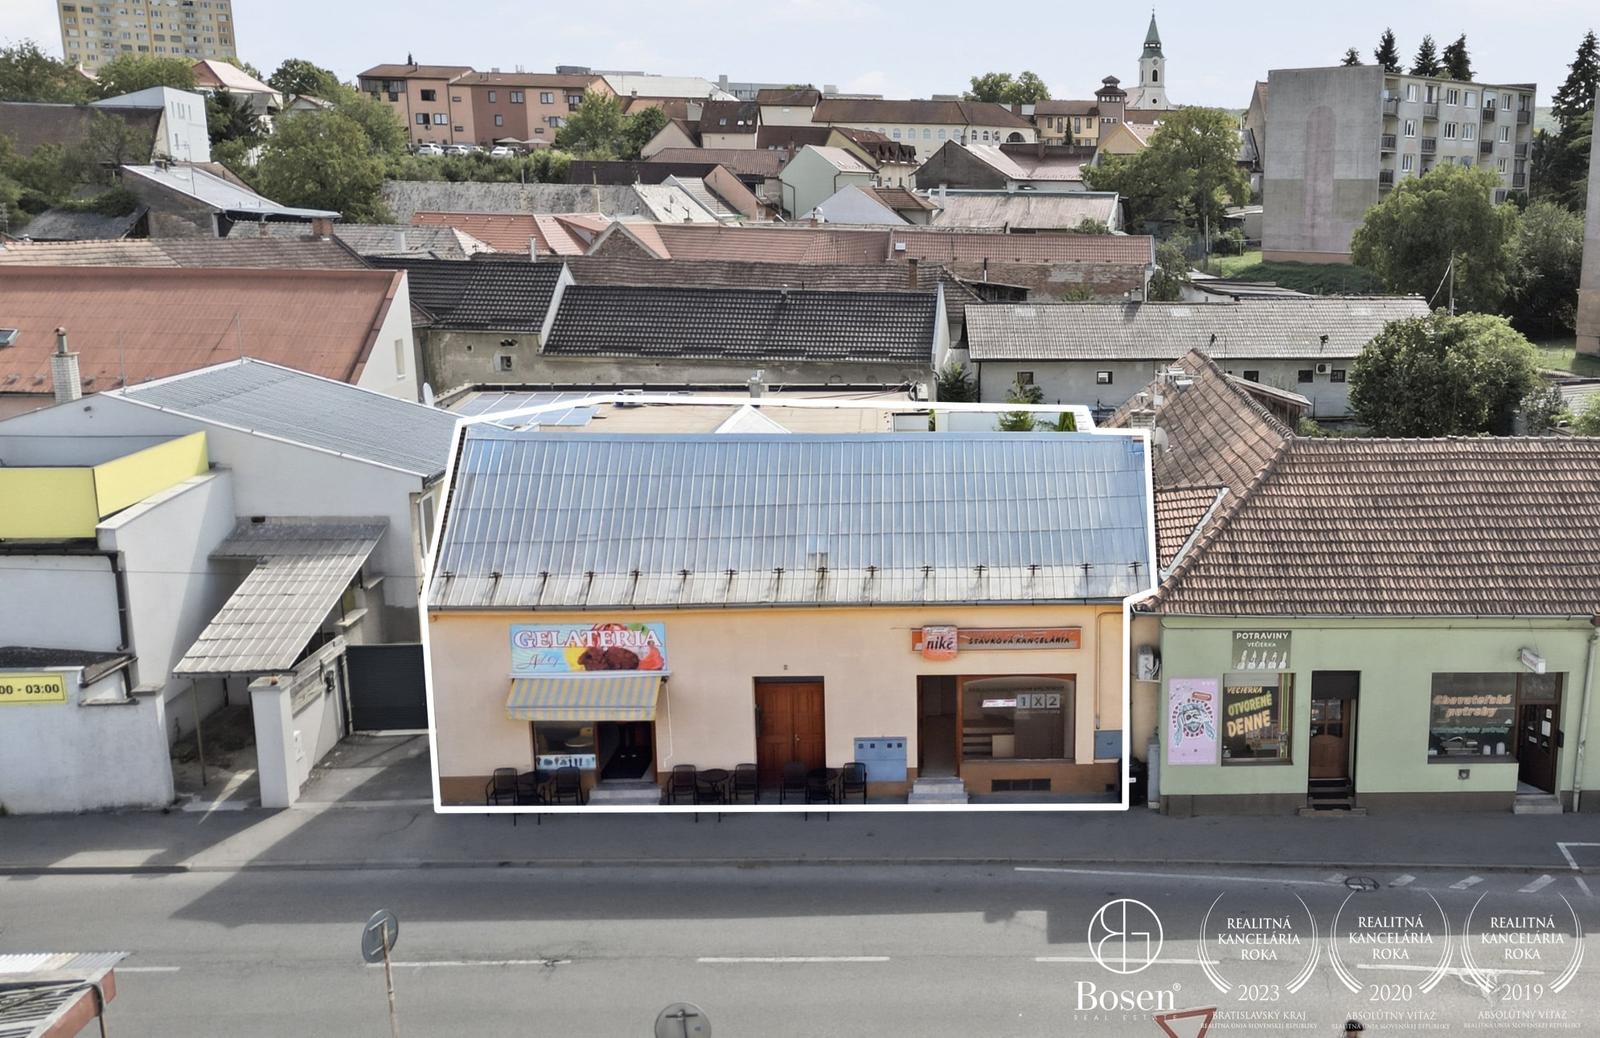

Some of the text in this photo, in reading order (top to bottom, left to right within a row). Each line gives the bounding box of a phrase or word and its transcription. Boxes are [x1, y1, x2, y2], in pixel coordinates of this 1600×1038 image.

[513, 630, 662, 648] GELATERIA
[1236, 632, 1289, 640] POTRAVINY
[25, 684, 60, 694] 03:00
[1228, 690, 1273, 716] OTVORENÉ
[1227, 710, 1271, 738] DENNE
